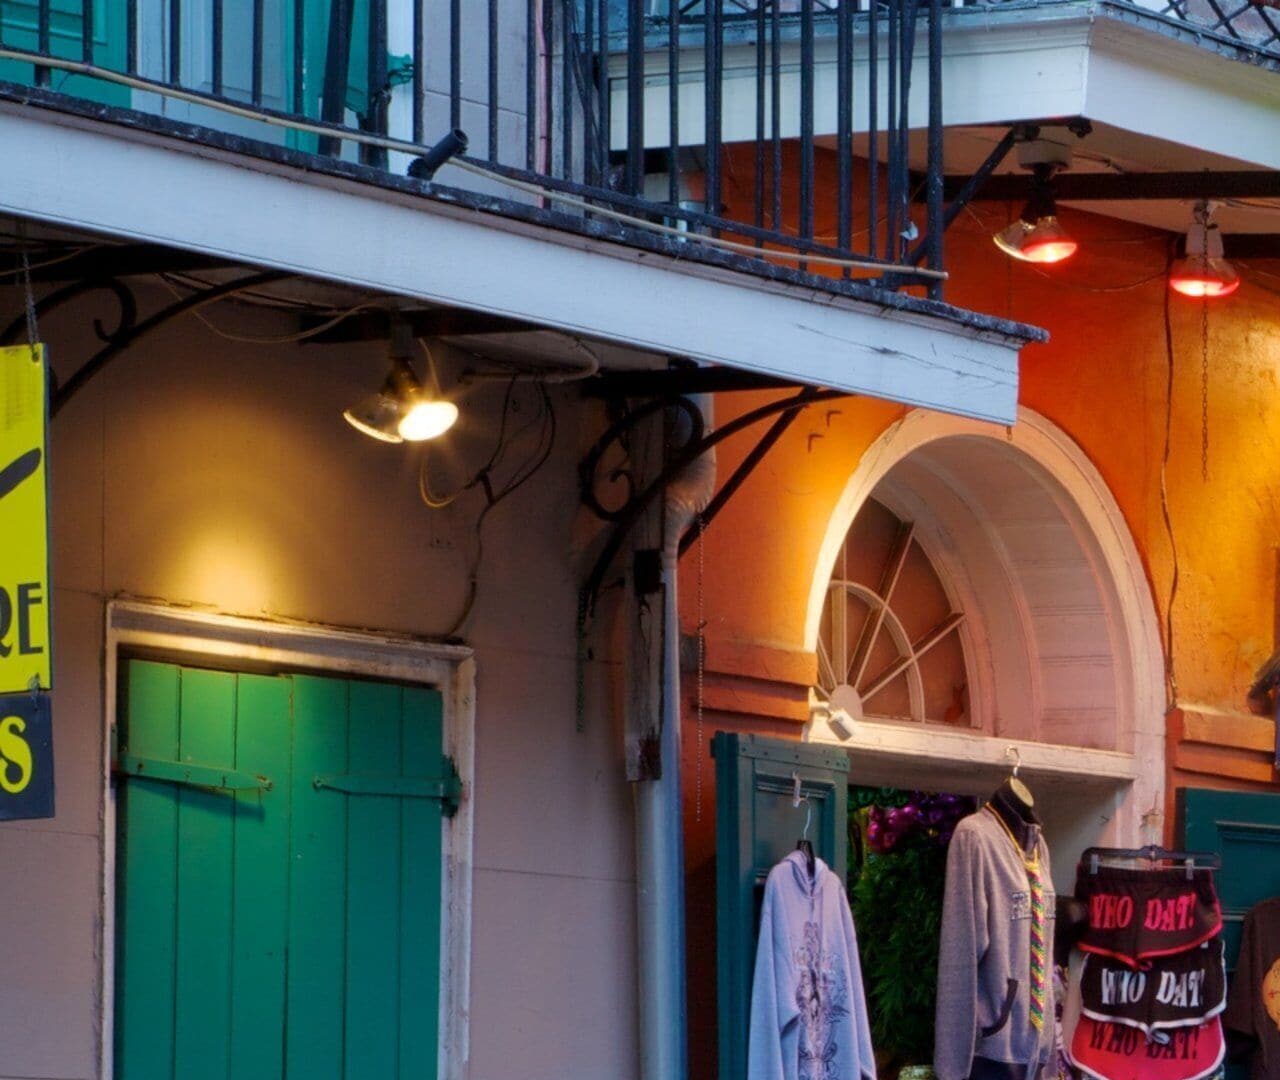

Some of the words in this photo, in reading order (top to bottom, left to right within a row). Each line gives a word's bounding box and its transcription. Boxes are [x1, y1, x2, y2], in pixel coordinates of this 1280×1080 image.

[1089, 893, 1133, 930] WHO
[1144, 892, 1197, 932] DAT!
[1101, 968, 1146, 1006] WHO
[1088, 1017, 1138, 1058] WHO
